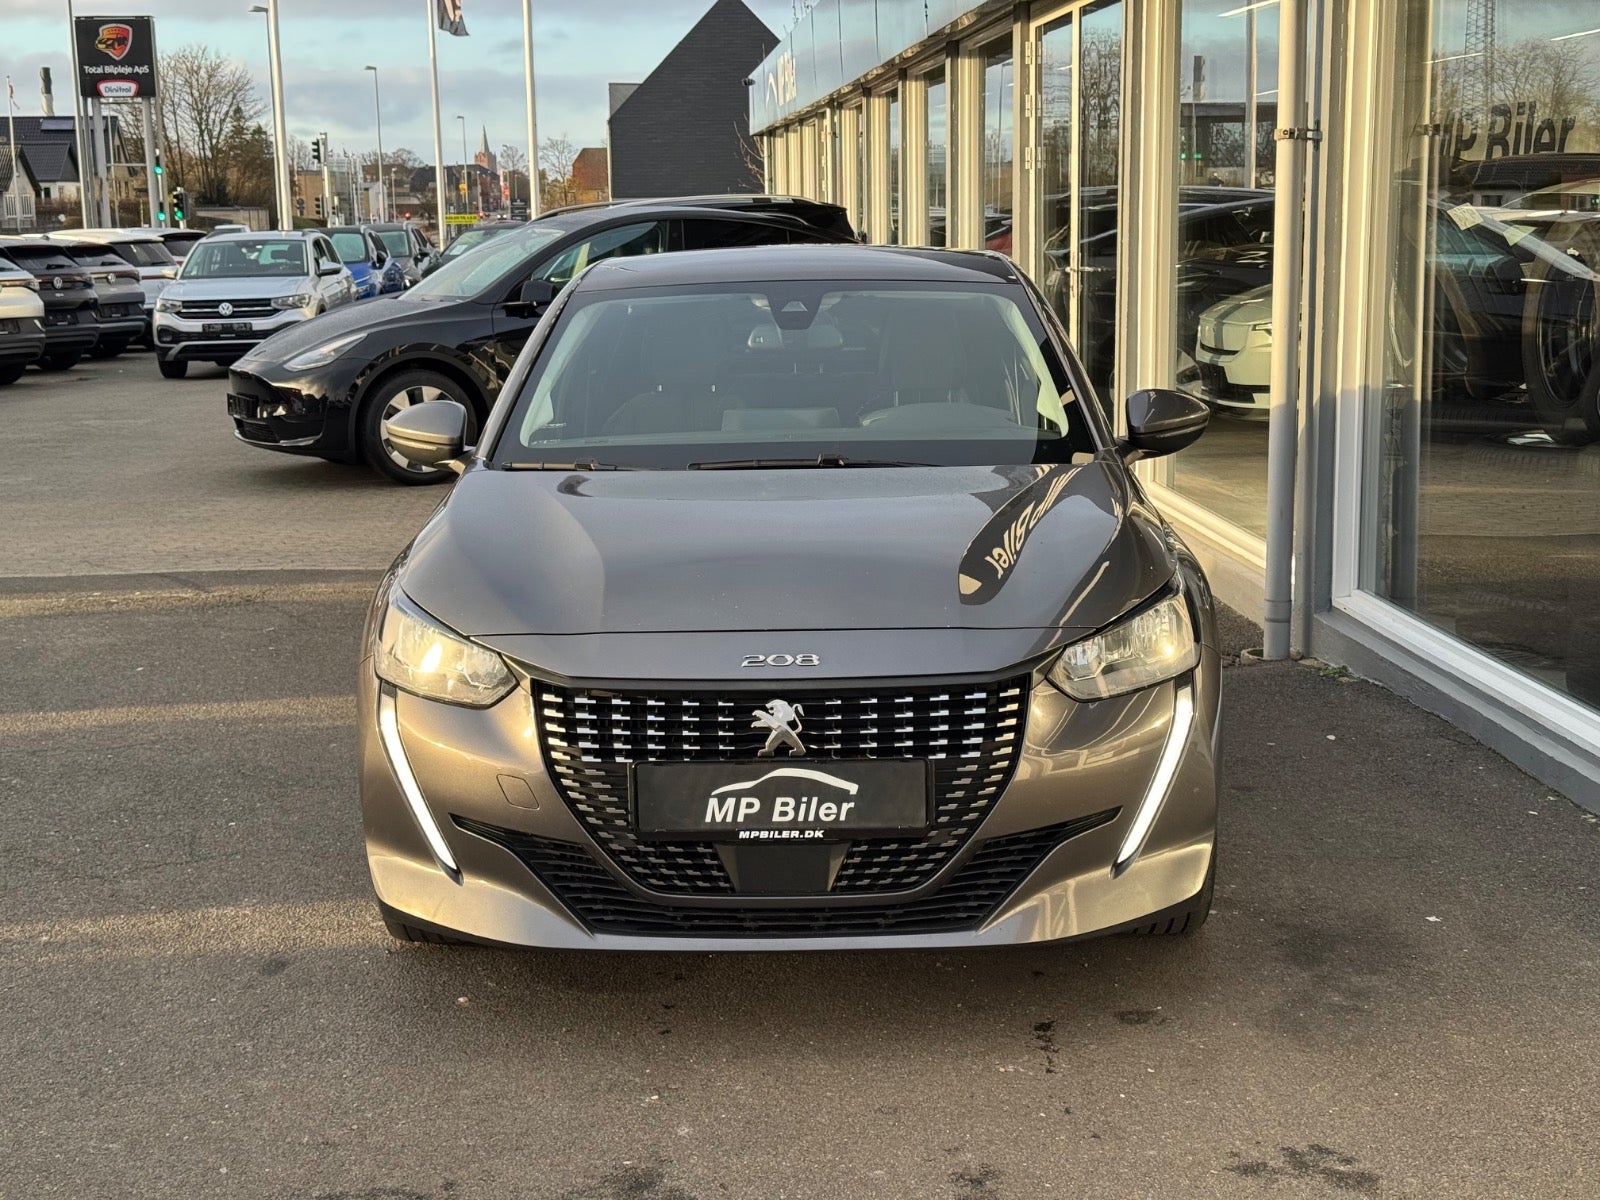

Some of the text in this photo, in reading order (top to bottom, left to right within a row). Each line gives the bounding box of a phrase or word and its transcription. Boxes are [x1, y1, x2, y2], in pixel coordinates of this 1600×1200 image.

[84, 65, 149, 75] Total Bilpleje ApS
[1484, 100, 1576, 160] Biler
[741, 653, 820, 668] 208
[704, 796, 855, 823] MP Biler
[738, 829, 824, 839] MPBILER.DK
